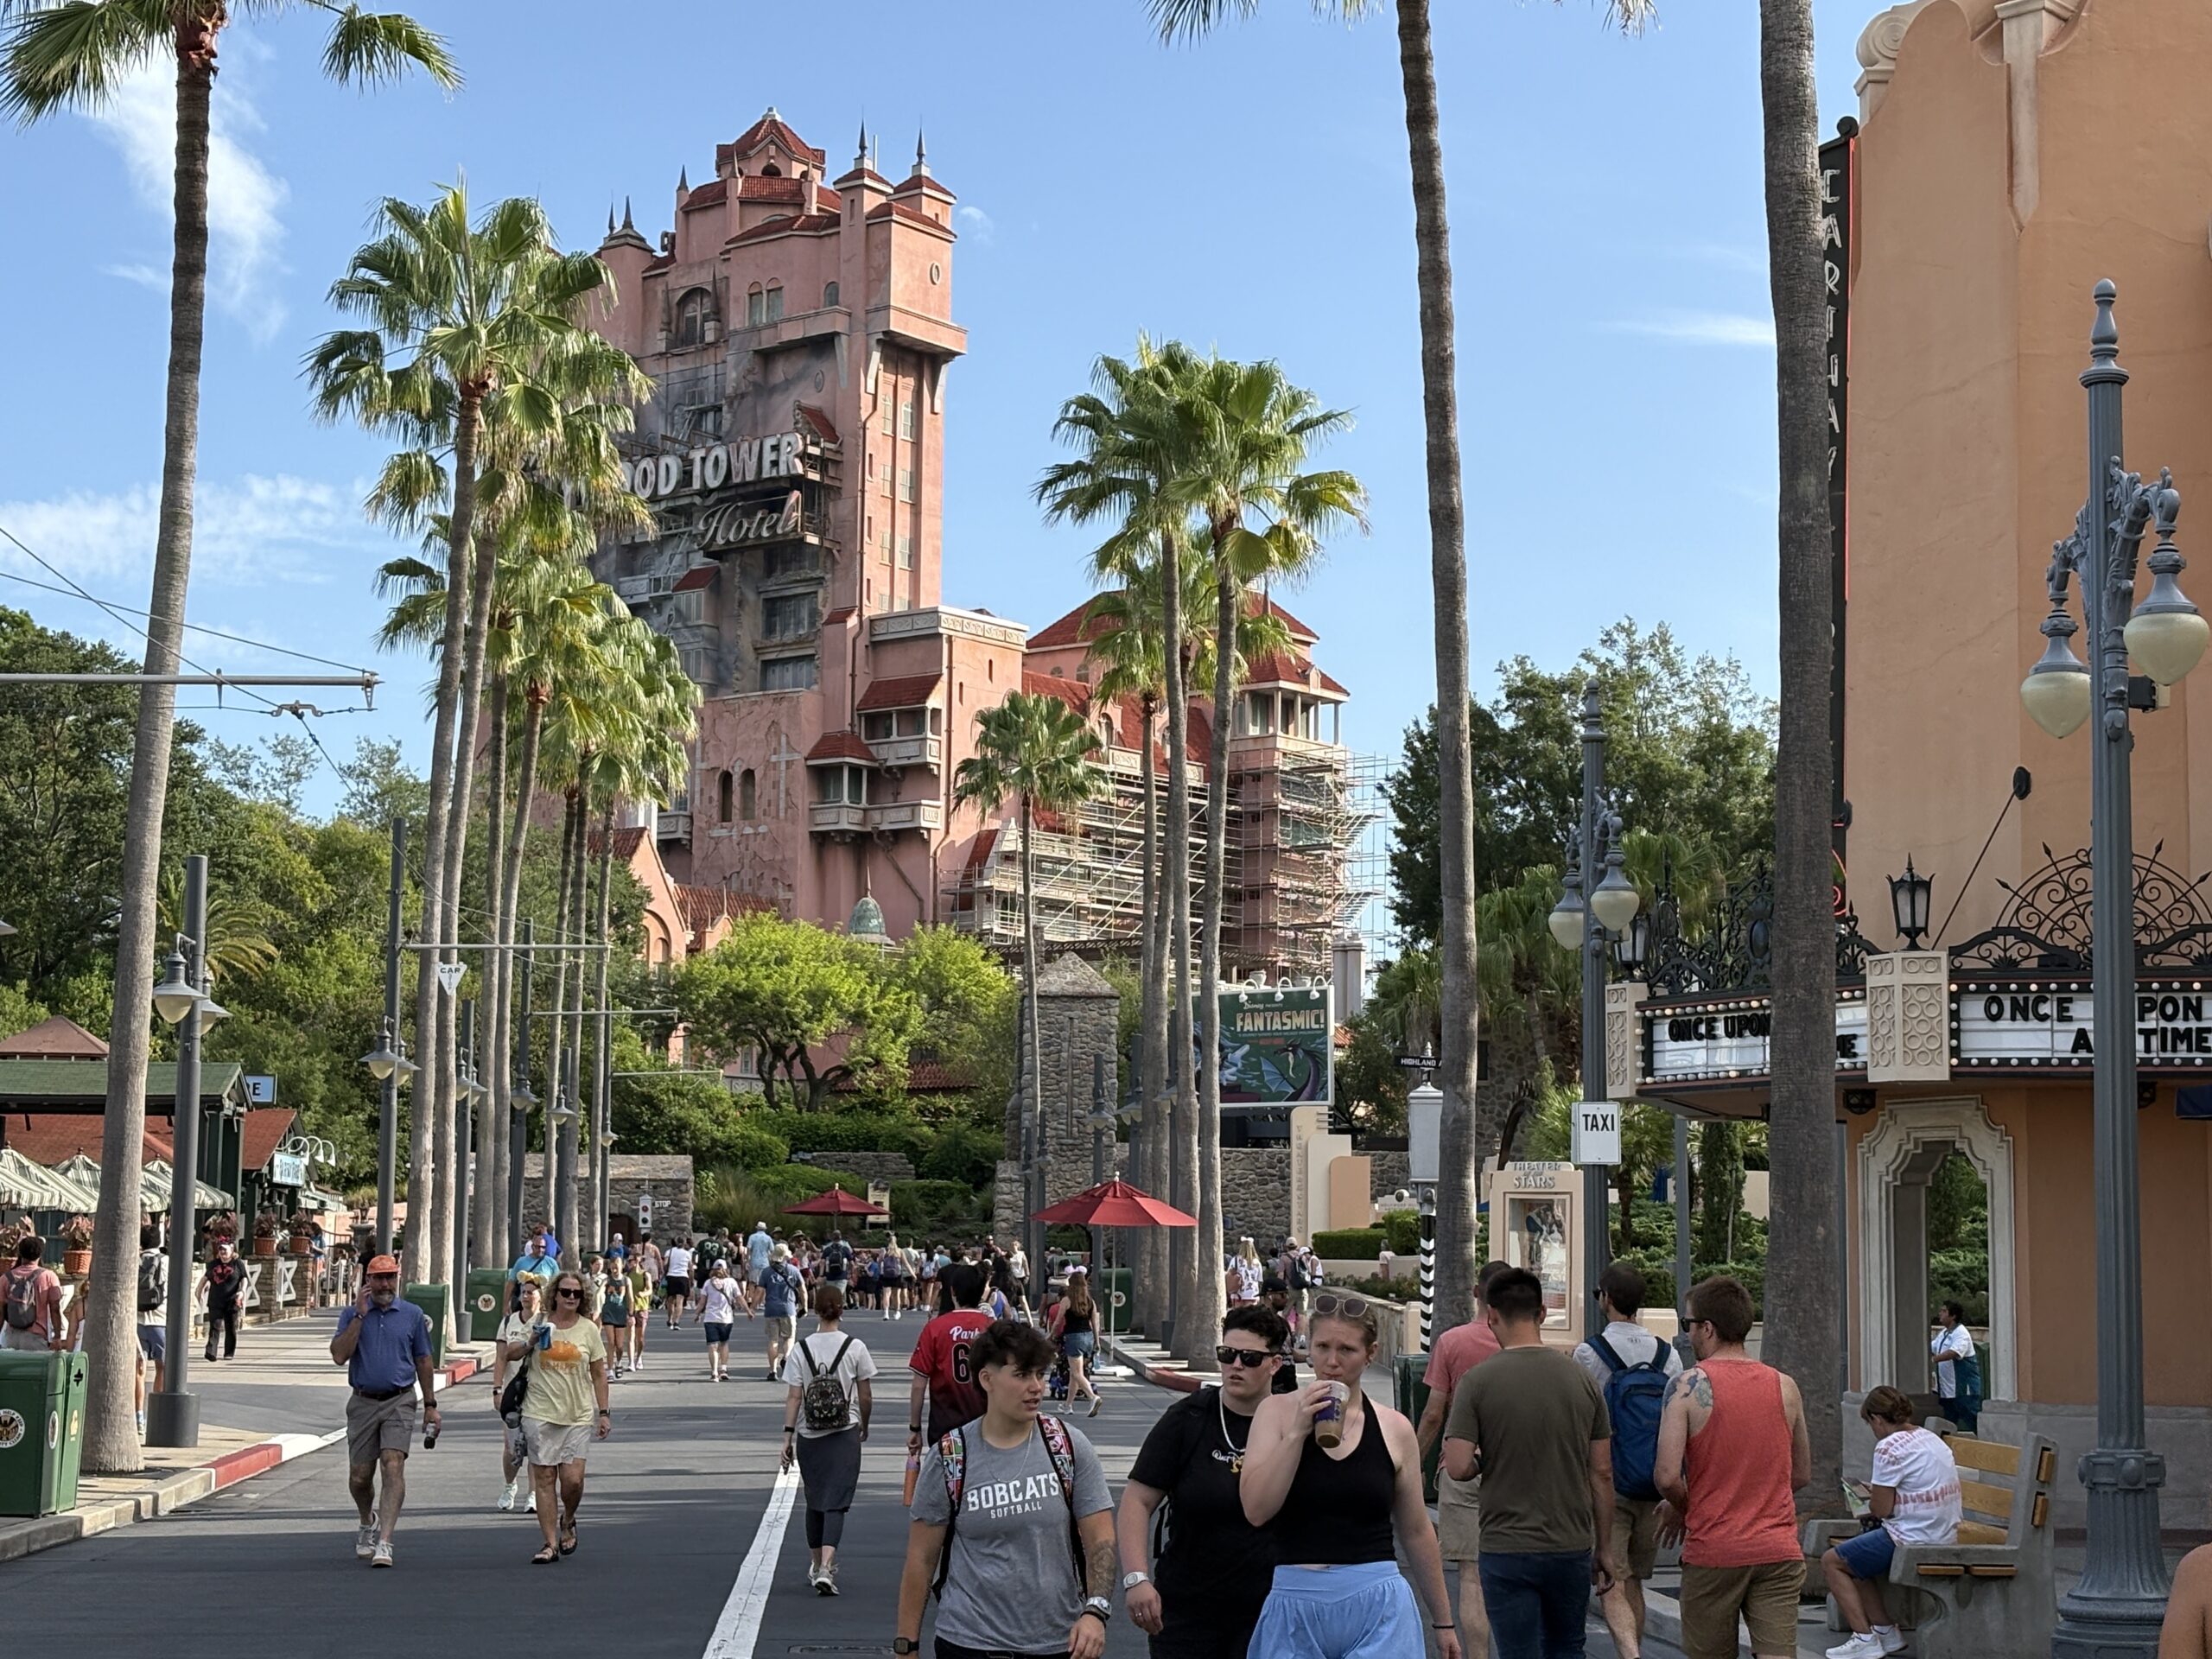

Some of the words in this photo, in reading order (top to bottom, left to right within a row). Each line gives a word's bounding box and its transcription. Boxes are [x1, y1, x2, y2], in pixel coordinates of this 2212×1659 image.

[689, 432, 805, 490] TOWER
[695, 489, 802, 550] Hotel
[1236, 1009, 1325, 1033] FANTASMIC!
[1984, 995, 2074, 1022] ONCE
[2138, 995, 2202, 1022] PON
[1669, 1016, 1719, 1043] ONCE
[2070, 1027, 2094, 1053] A
[2138, 1027, 2212, 1054] TIME
[1401, 1058, 1437, 1067] HIGHLAND
[1582, 1114, 1615, 1132] TAXI
[1514, 1162, 1561, 1172] THEATER
[1513, 1175, 1555, 1189] STARS
[967, 1471, 1059, 1512] BOBCATS
[990, 1501, 1043, 1519] SOFTBALL
